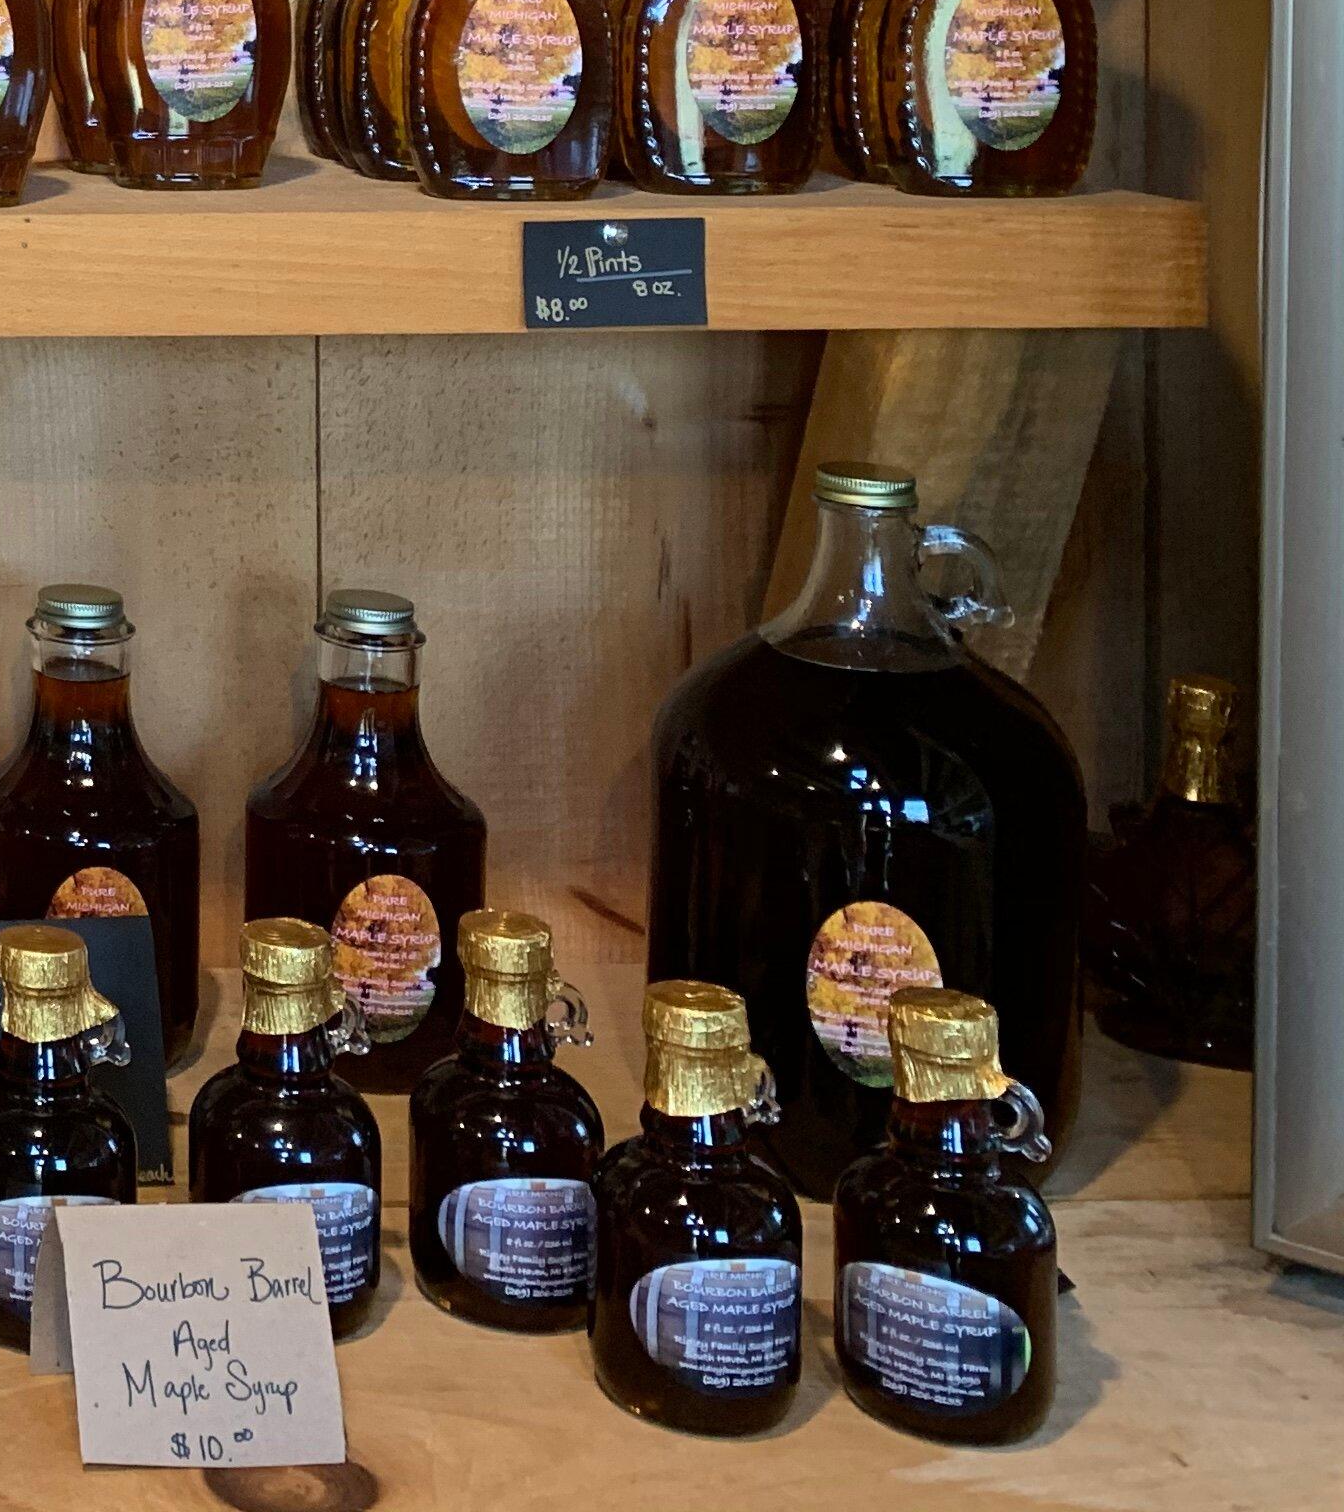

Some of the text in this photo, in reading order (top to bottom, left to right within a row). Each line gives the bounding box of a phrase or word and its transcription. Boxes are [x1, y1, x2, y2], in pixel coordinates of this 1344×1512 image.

[557, 245, 642, 279] 1/2 Pints
[633, 280, 648, 297] 8
[93, 1258, 322, 1310] Bourbon Barrel
[673, 1280, 793, 1298] BOURBON BARREL
[666, 1295, 796, 1317] AGED MAPLE SYRUP
[172, 1320, 231, 1372] Aged
[122, 1359, 298, 1415] Maple Syrup
